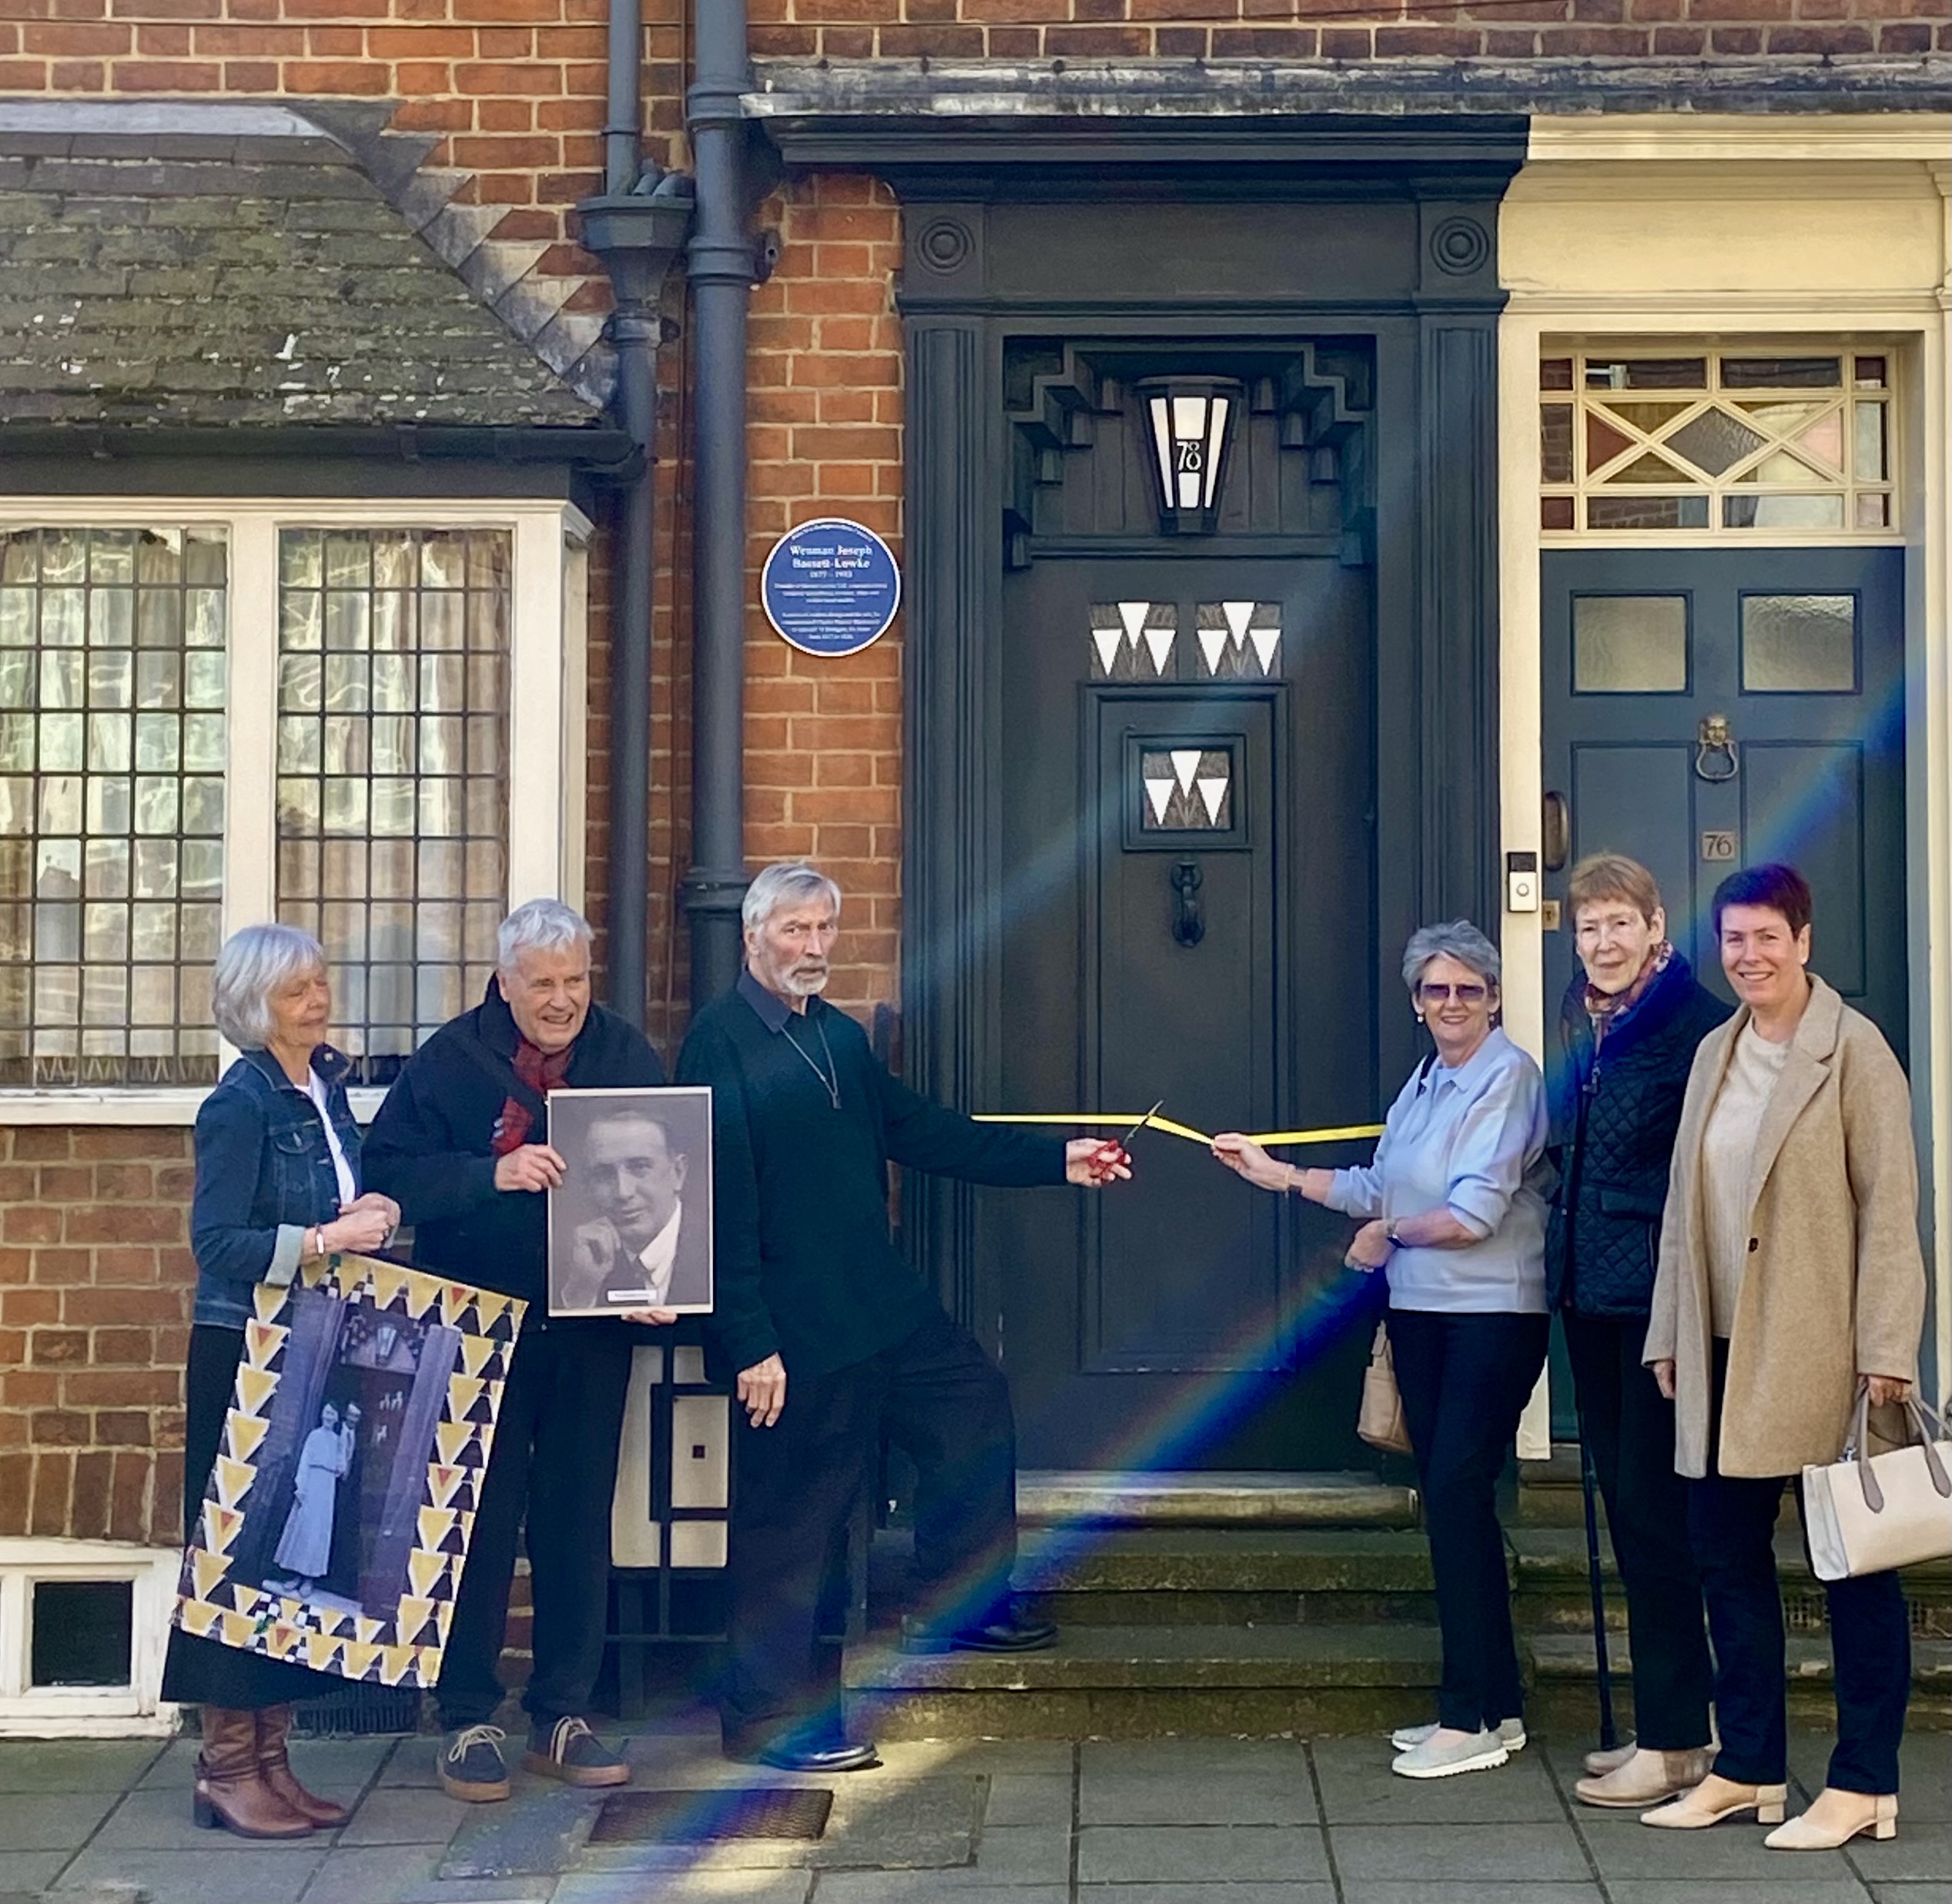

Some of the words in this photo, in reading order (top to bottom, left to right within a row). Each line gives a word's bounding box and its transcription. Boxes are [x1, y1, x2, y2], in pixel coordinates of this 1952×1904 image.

[1177, 440, 1202, 470] 78
[837, 544, 872, 558] Joseph
[1704, 835, 1732, 857] 76
